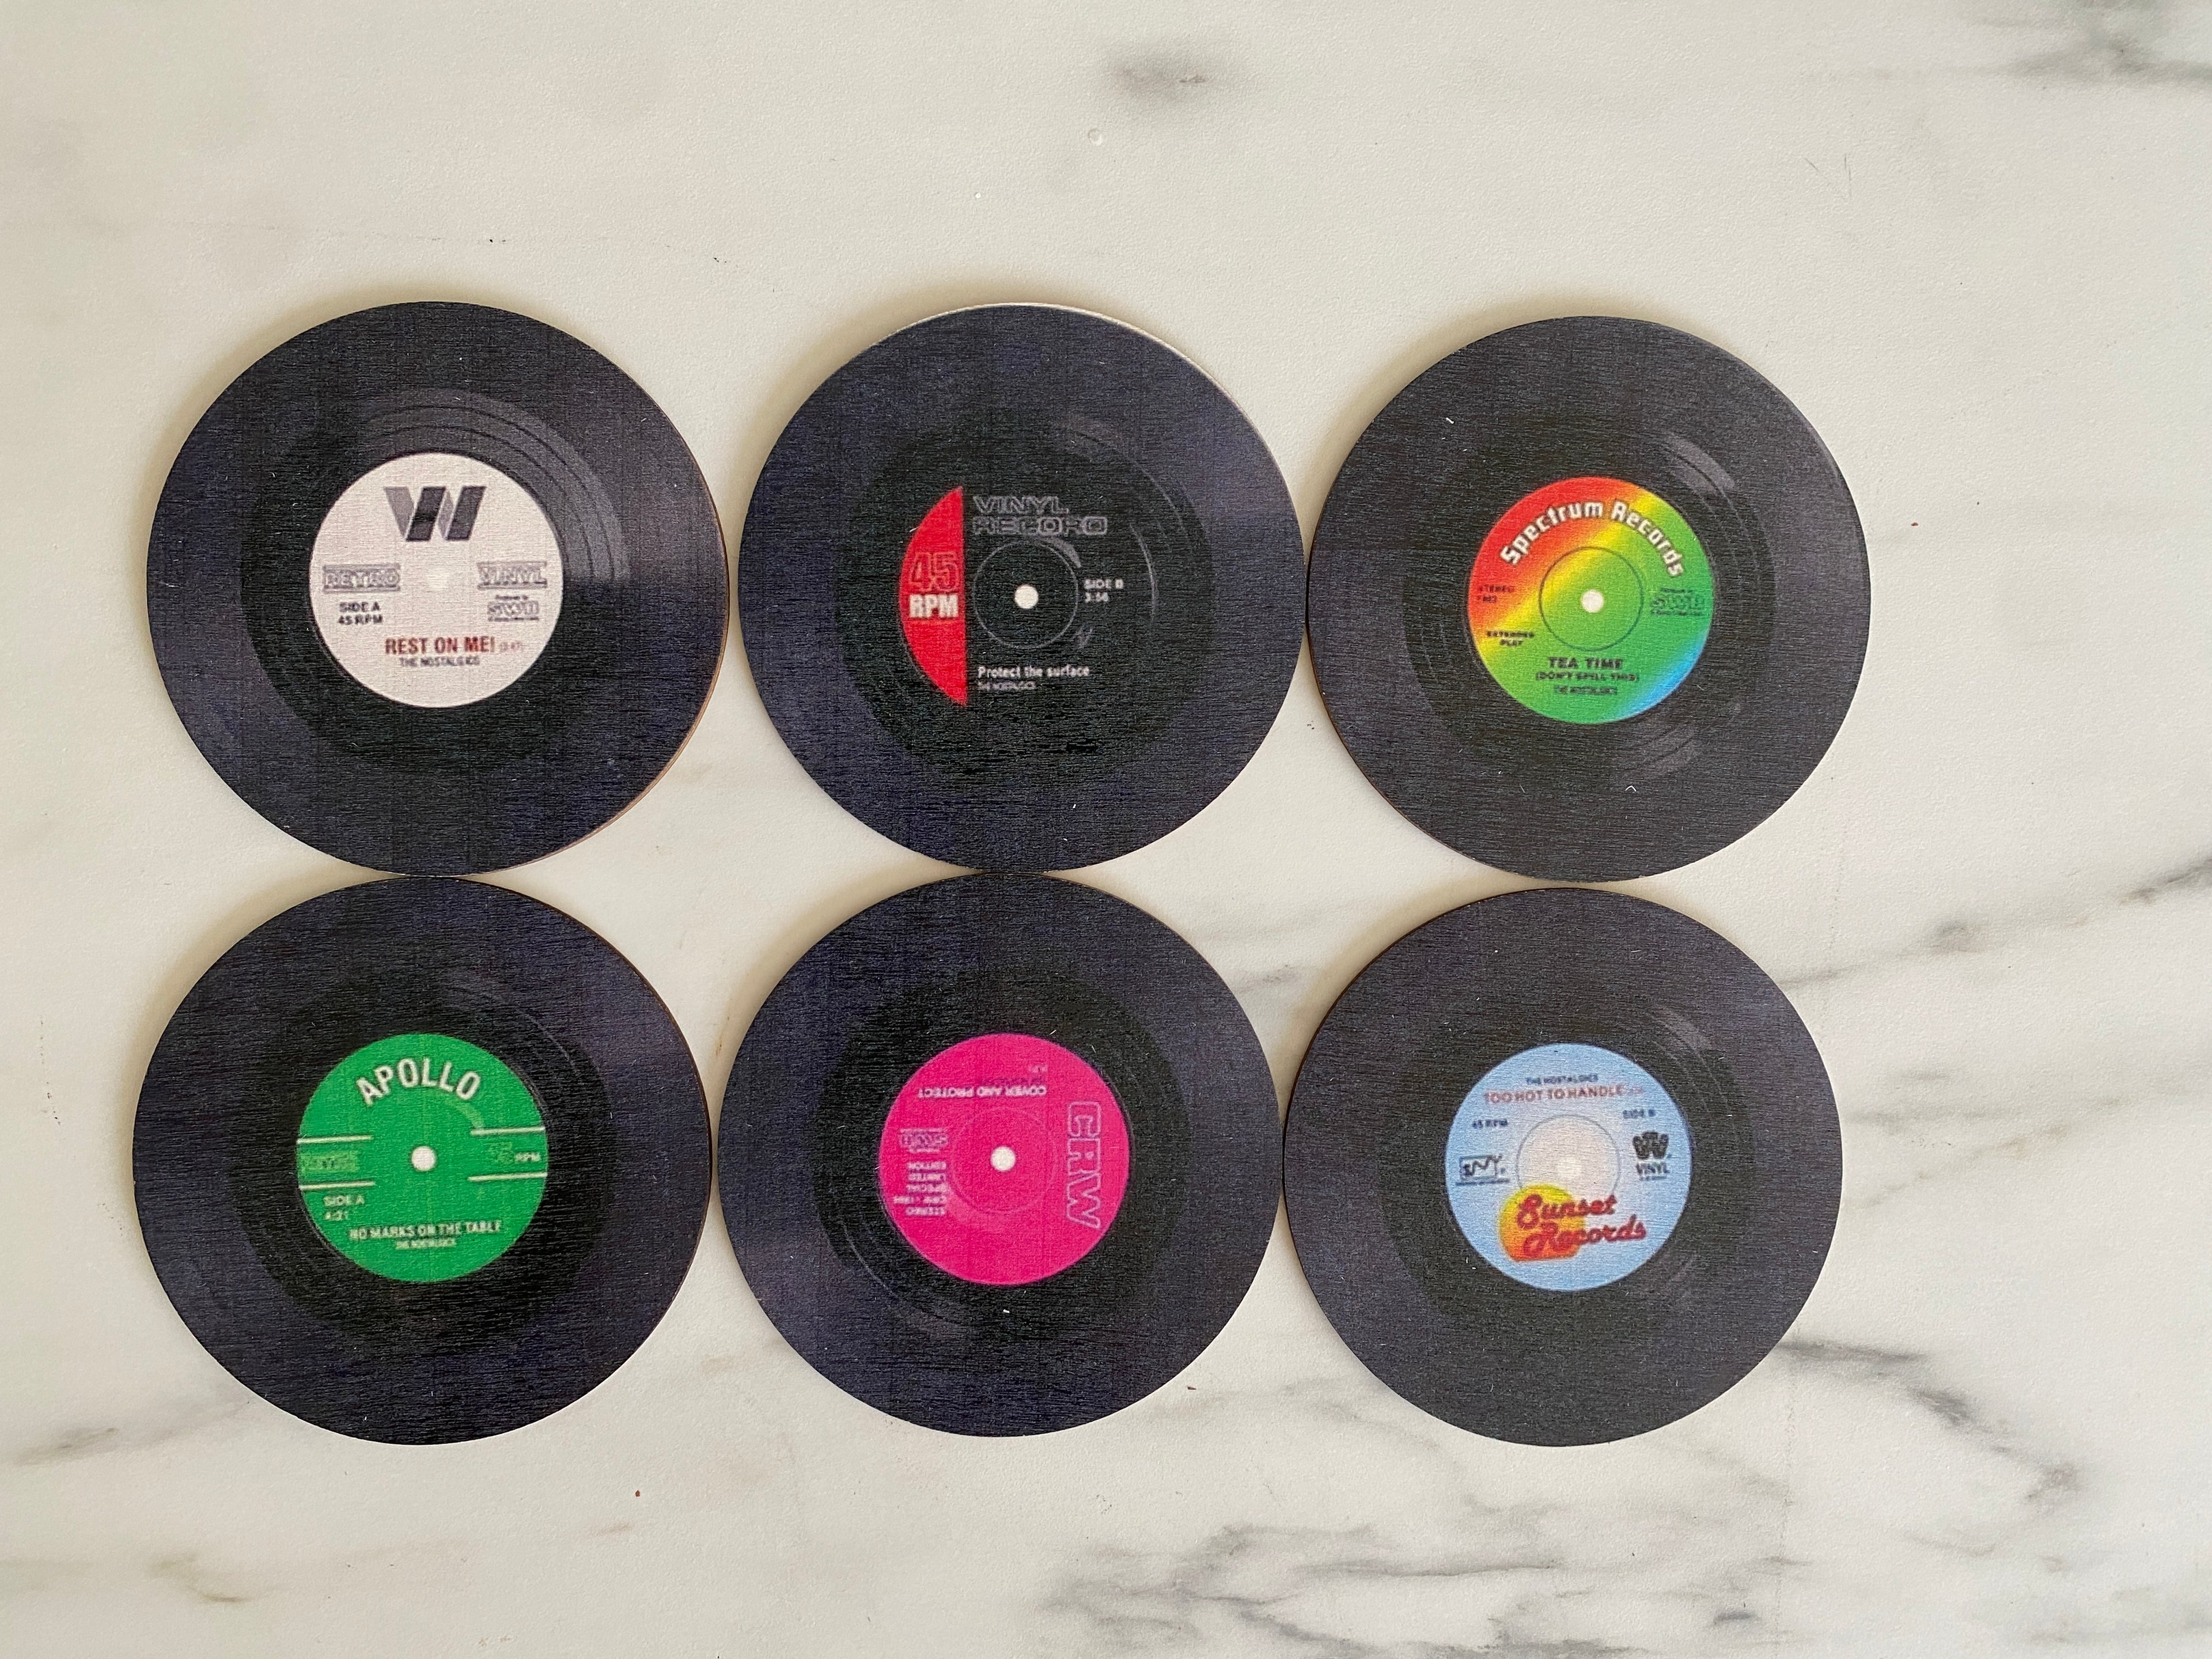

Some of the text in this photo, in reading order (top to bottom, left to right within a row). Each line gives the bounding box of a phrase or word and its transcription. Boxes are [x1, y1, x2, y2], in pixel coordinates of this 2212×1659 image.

[973, 495, 1069, 514] VINYL
[973, 516, 1108, 536] RECORD
[1500, 499, 1684, 577] Spectrum Records
[909, 551, 959, 592] 45
[1084, 578, 1112, 590] SIDE
[339, 601, 381, 612] SIDE A
[909, 594, 959, 618] RPM
[338, 614, 384, 626] 45 RPM
[384, 637, 428, 655] REST
[434, 637, 458, 654] ON
[463, 635, 495, 653] ME!
[399, 657, 418, 667] THE
[978, 664, 1090, 679] Protect the surface
[1548, 657, 1623, 669] TEA TIME
[355, 1058, 482, 1107] APOLLO
[1527, 1077, 1541, 1086] THE
[918, 1085, 1047, 1099] COVER AND PROTECT
[1484, 1091, 1511, 1104] TOO
[1512, 1089, 1543, 1103] HOT
[1547, 1088, 1563, 1100] TO
[1566, 1084, 1623, 1099] HANDLE
[1471, 1120, 1484, 1130] 45
[1066, 1101, 1101, 1229] CRW
[323, 1194, 365, 1207] SIDE A
[1517, 1194, 1618, 1230] Sunset
[349, 1219, 502, 1241] NO MARKS ON THE TABLE
[1522, 1214, 1647, 1258] Records
